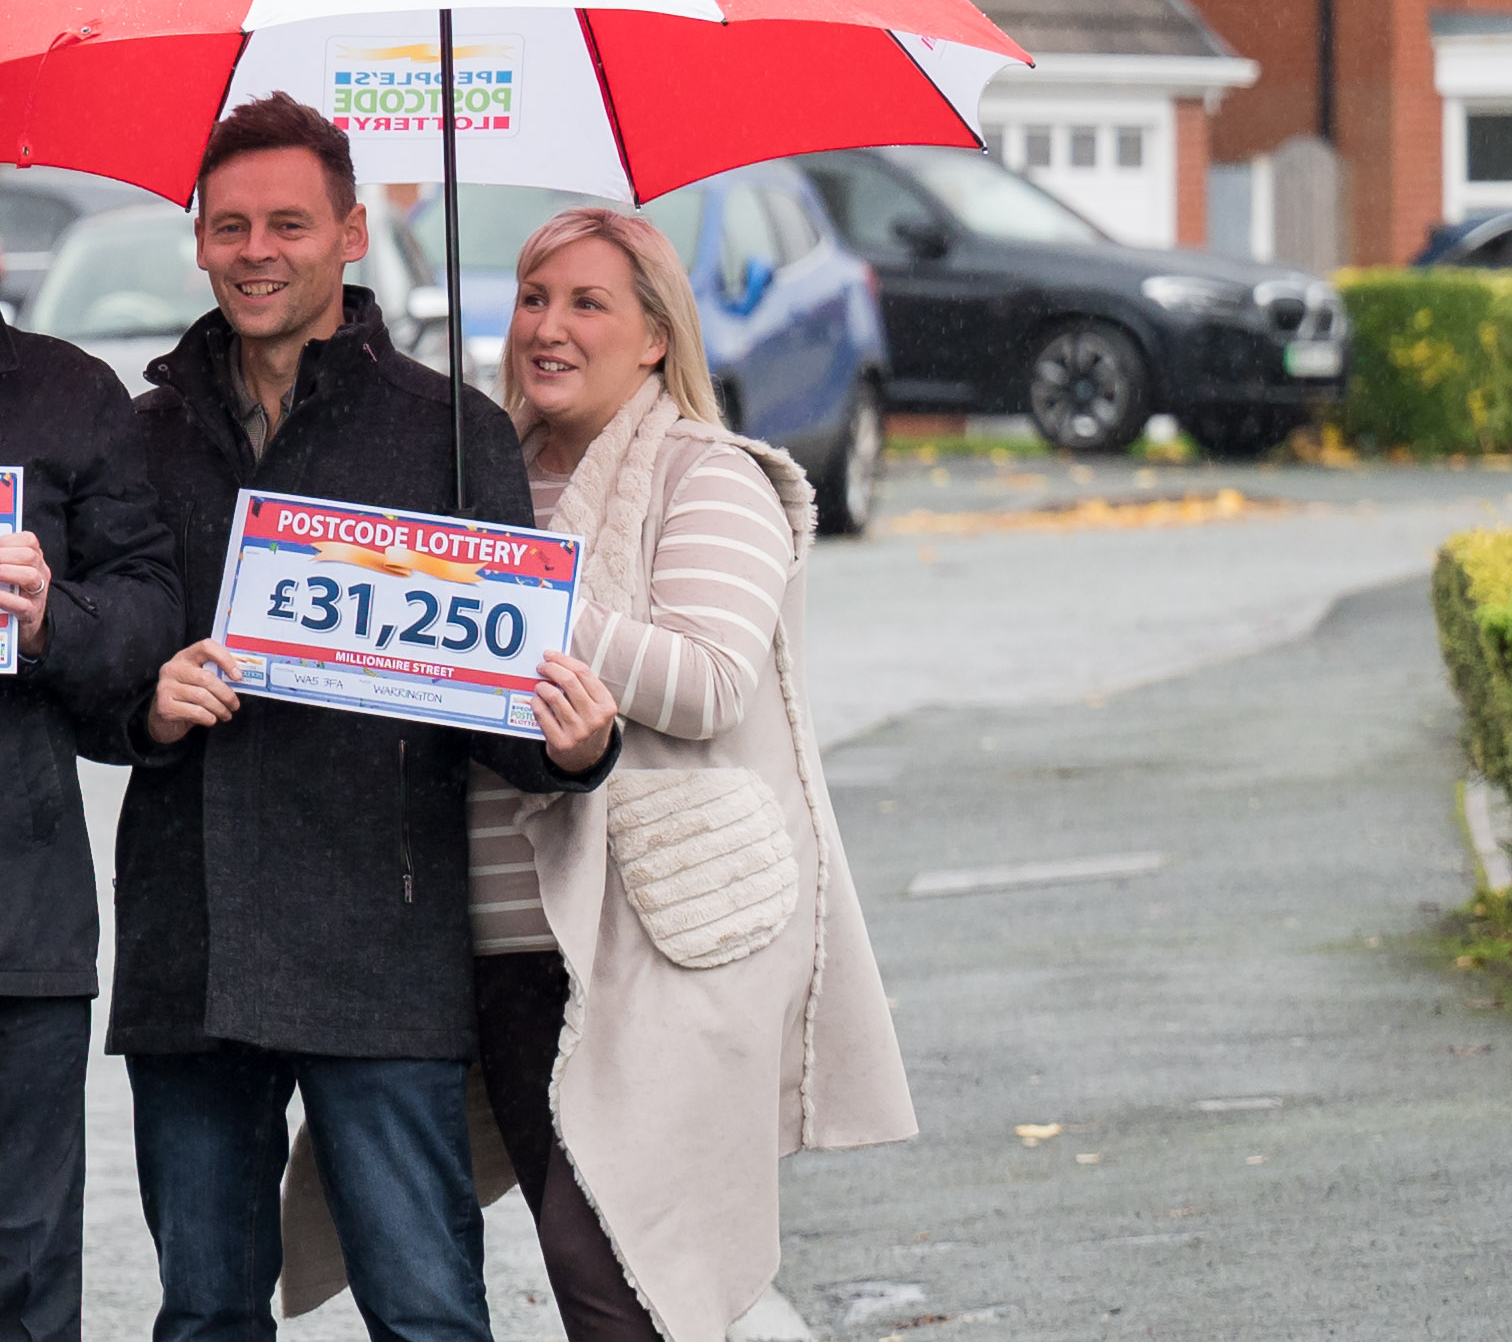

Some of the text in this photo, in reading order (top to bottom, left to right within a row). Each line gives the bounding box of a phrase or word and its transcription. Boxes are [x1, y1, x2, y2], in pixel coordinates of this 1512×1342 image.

[277, 509, 528, 567] POSTCODE LOTTERY
[268, 576, 526, 658] £31,250
[335, 651, 454, 678] MILLIONAIRE STREET
[295, 674, 443, 704] WA5 3FA WARRINGTON
